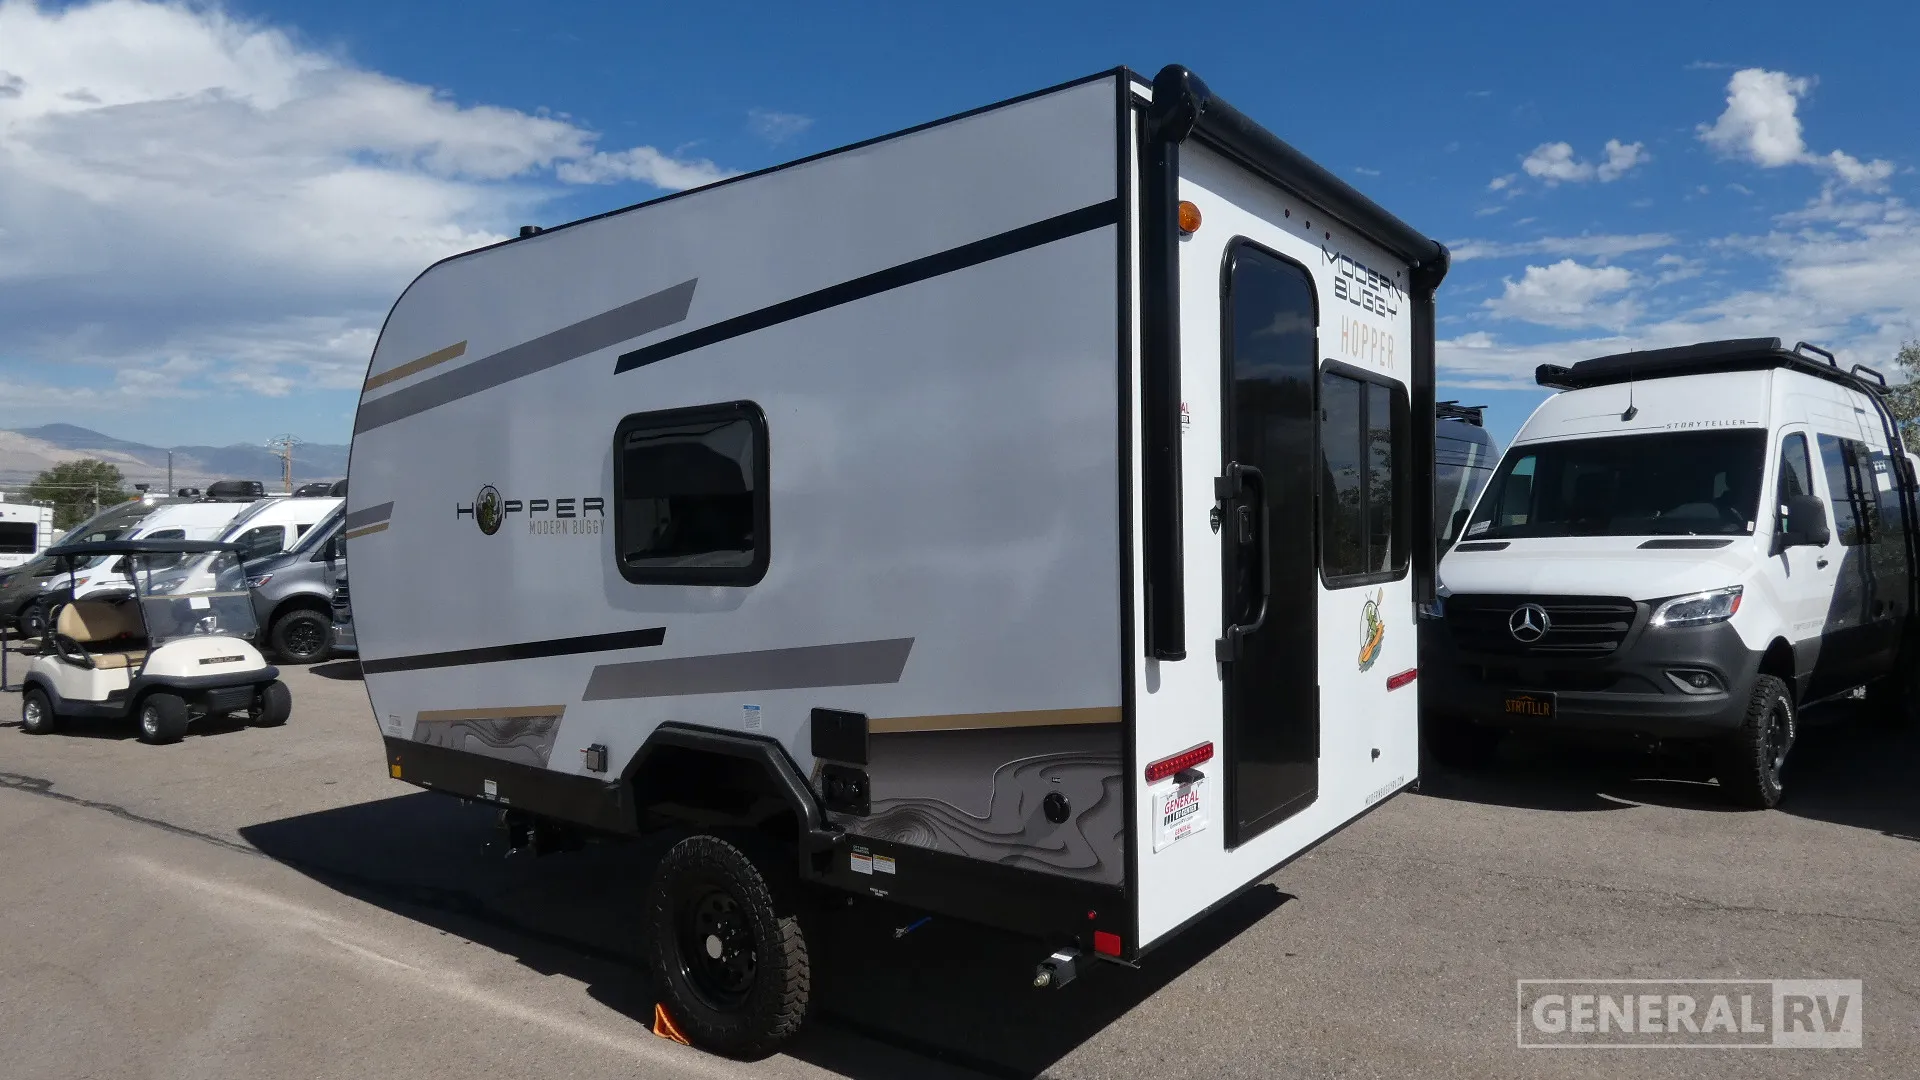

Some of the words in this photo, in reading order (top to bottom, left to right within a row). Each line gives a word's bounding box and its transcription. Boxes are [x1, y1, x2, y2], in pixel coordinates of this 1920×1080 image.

[1321, 244, 1403, 303] MODERN
[1334, 275, 1398, 321] BUGGY
[1341, 314, 1394, 370] HOPPER
[1666, 419, 1746, 430] STORYTELLER
[529, 519, 568, 535] MODERN
[572, 519, 605, 535] BUGGY
[1505, 699, 1550, 716] STRYTLLR
[1164, 790, 1199, 814] GENERAL
